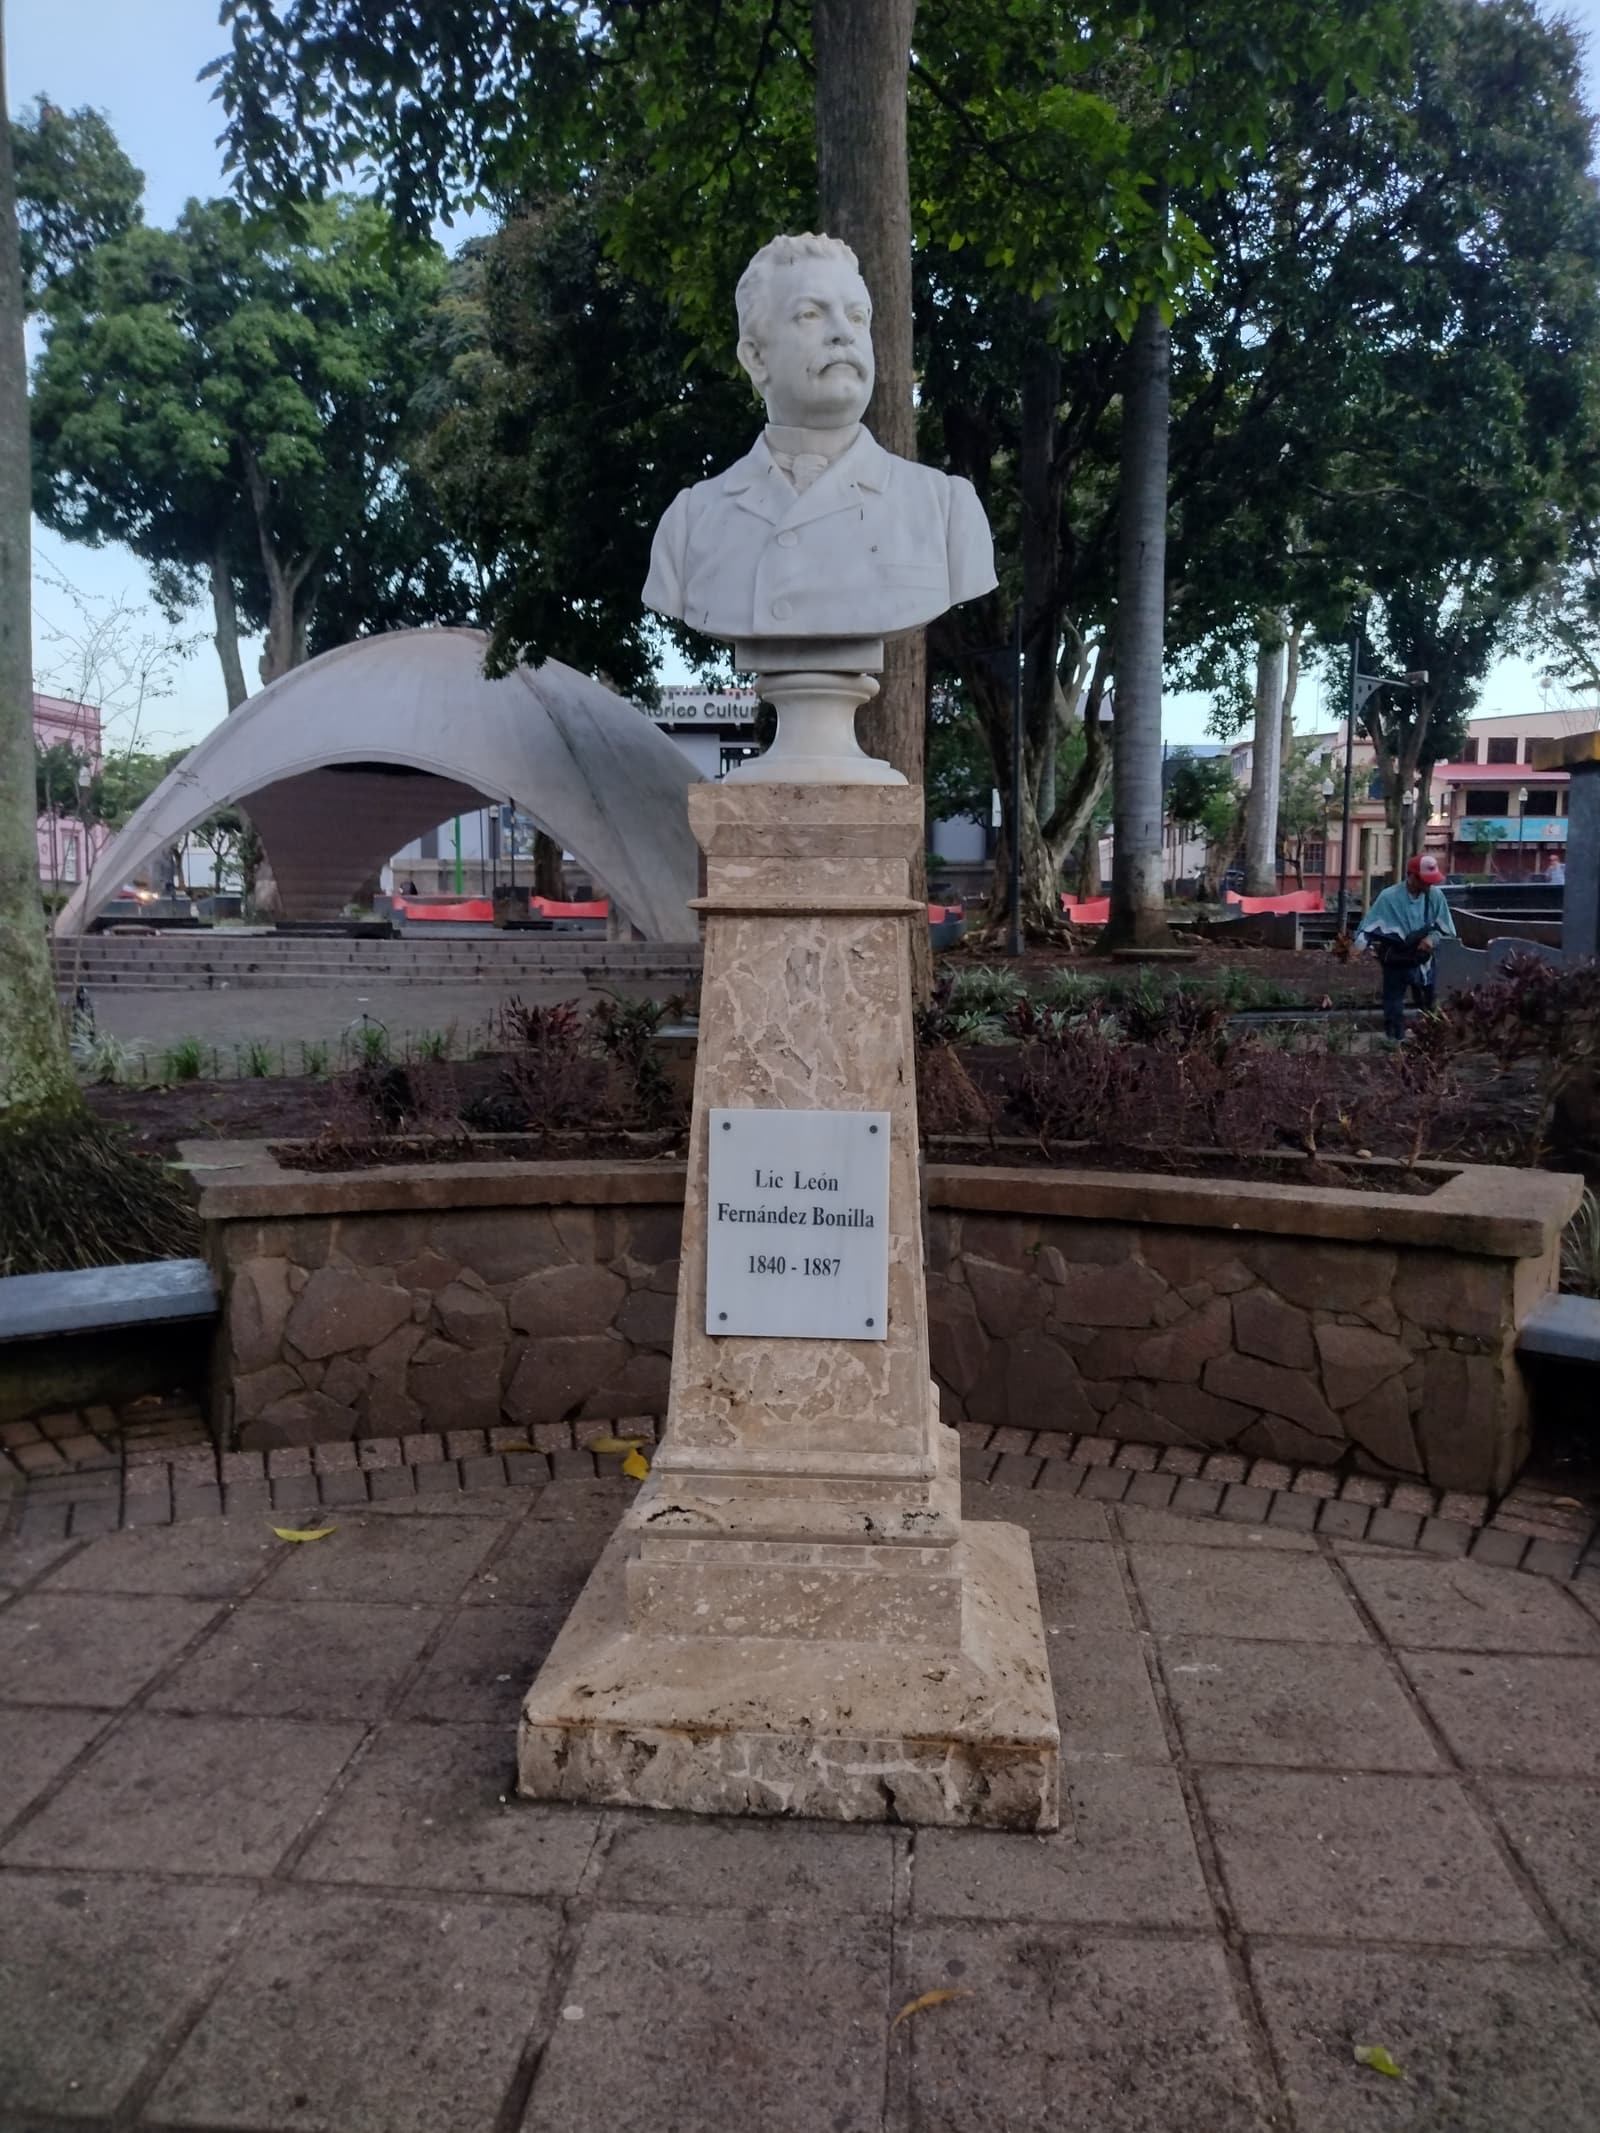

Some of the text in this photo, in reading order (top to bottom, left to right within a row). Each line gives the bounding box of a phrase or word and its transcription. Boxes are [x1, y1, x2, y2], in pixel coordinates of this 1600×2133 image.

[755, 1169, 839, 1192] Lic León
[718, 1203, 875, 1229] Fernández Bonilla
[748, 1255, 786, 1275] 1840
[803, 1257, 841, 1277] 1887
